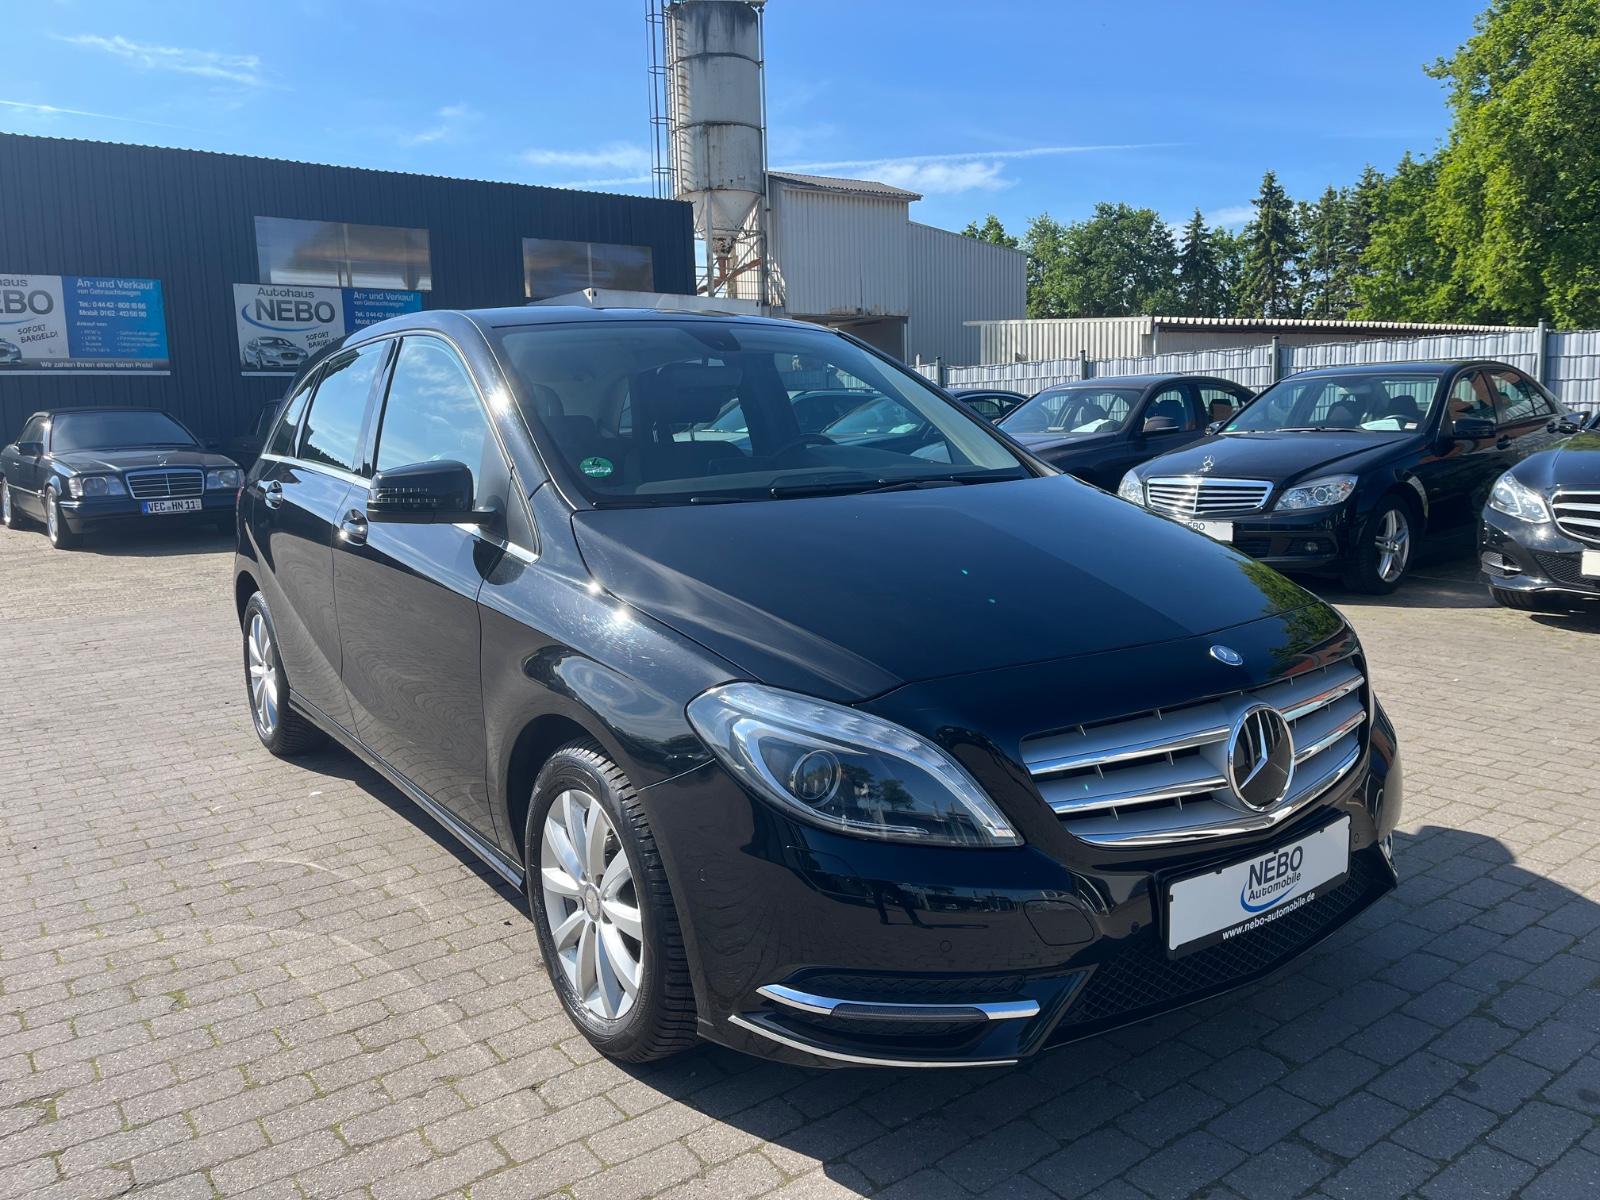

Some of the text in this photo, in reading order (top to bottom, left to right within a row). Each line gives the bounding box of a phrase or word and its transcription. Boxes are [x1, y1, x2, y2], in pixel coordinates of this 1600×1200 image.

[77, 279, 153, 290] An- und Verkauf
[257, 287, 315, 299] Autohaus
[353, 291, 414, 302] An- und Verkauf
[0, 289, 54, 315] BO
[254, 298, 336, 323] NEBO
[17, 324, 46, 335] SOFORT
[20, 330, 59, 343] BARGELD!
[305, 331, 329, 341] SOFORT
[148, 500, 196, 512] VEC HN 11
[1185, 521, 1205, 531] EBO
[1248, 845, 1304, 890] NEBO
[1248, 871, 1302, 902] Automobile
[1222, 892, 1316, 940] www.nebo-automobile.de
